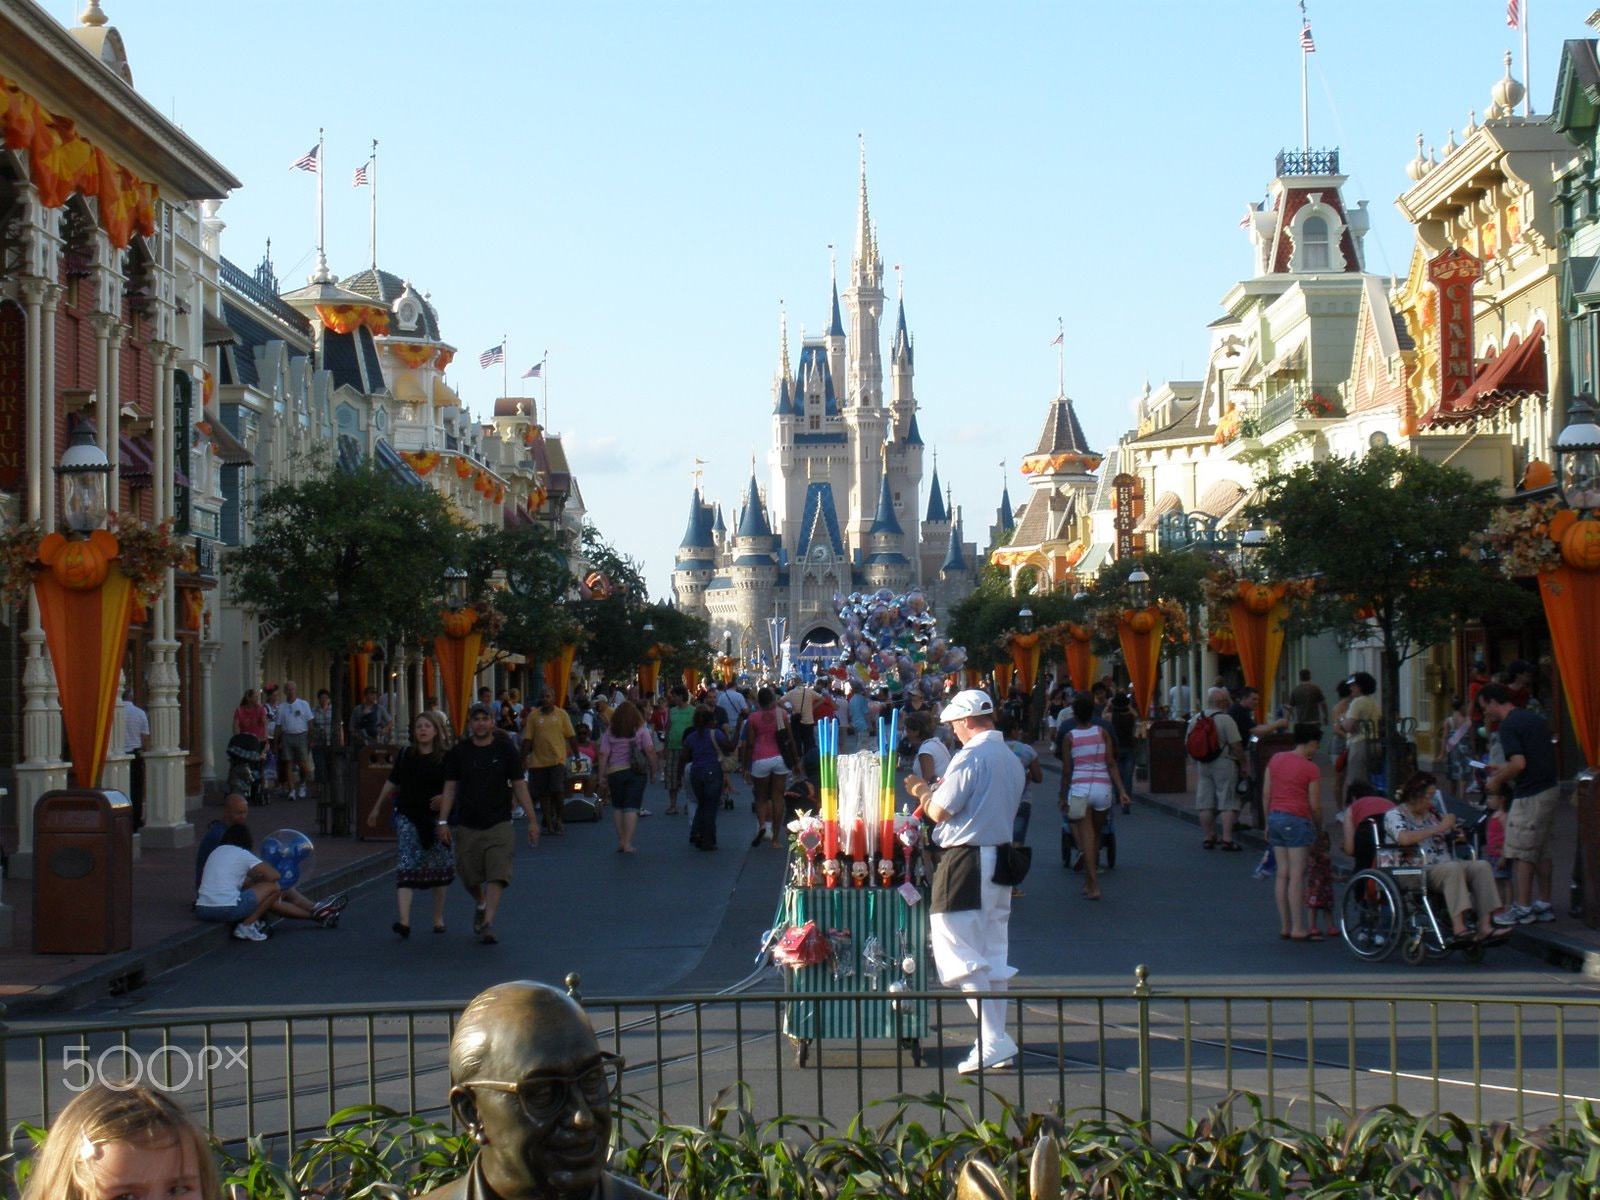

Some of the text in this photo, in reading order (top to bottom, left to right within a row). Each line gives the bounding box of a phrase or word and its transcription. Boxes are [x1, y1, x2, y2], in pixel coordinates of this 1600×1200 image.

[1432, 259, 1474, 276] MAIN
[1446, 284, 1469, 395] CINEMA
[0, 322, 19, 469] EMPORIUM
[173, 383, 184, 521] ARCADE
[1120, 487, 1130, 530] CRYSTAL
